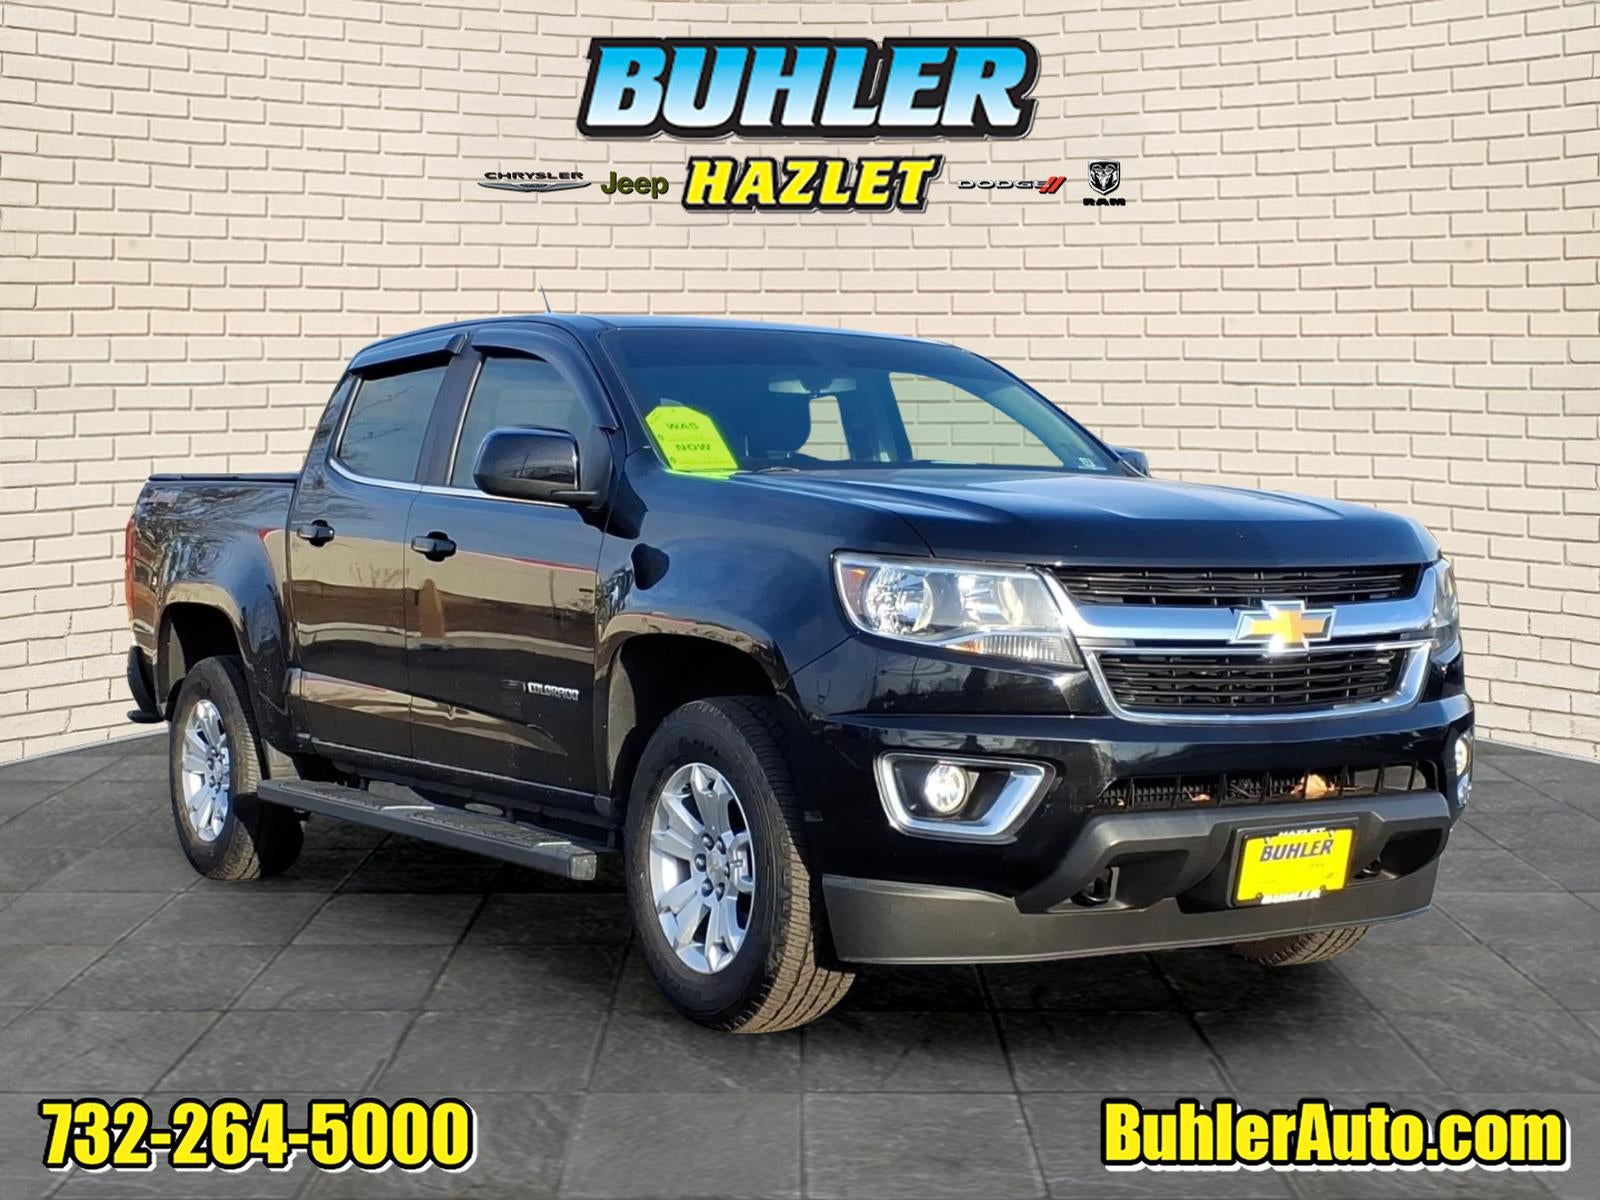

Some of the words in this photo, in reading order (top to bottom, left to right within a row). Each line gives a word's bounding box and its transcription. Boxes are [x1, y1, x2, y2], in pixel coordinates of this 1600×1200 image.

[666, 422, 699, 430] WAS
[676, 443, 710, 451] NOW
[1260, 839, 1334, 862] BUHLER
